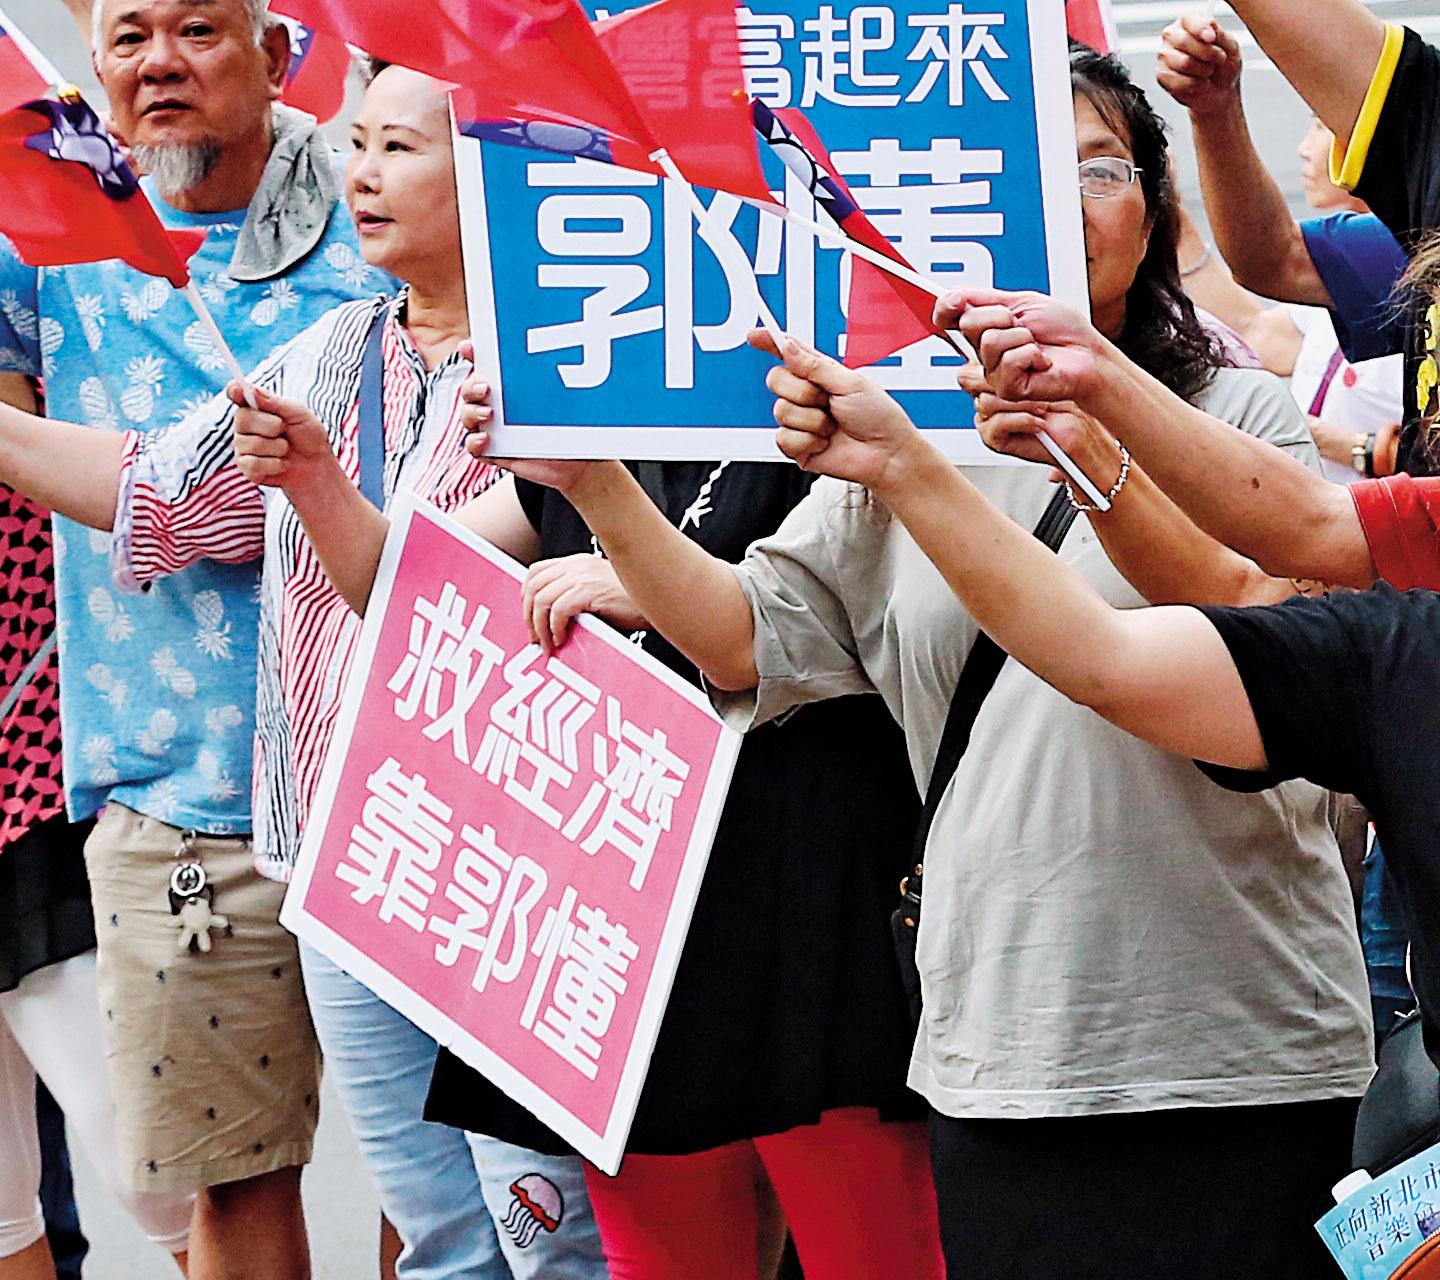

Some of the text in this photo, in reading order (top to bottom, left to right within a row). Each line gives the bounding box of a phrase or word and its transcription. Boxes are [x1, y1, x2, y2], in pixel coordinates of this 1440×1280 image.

[387, 581, 690, 892] 救經濟
[334, 757, 640, 1081] 靠郭懂
